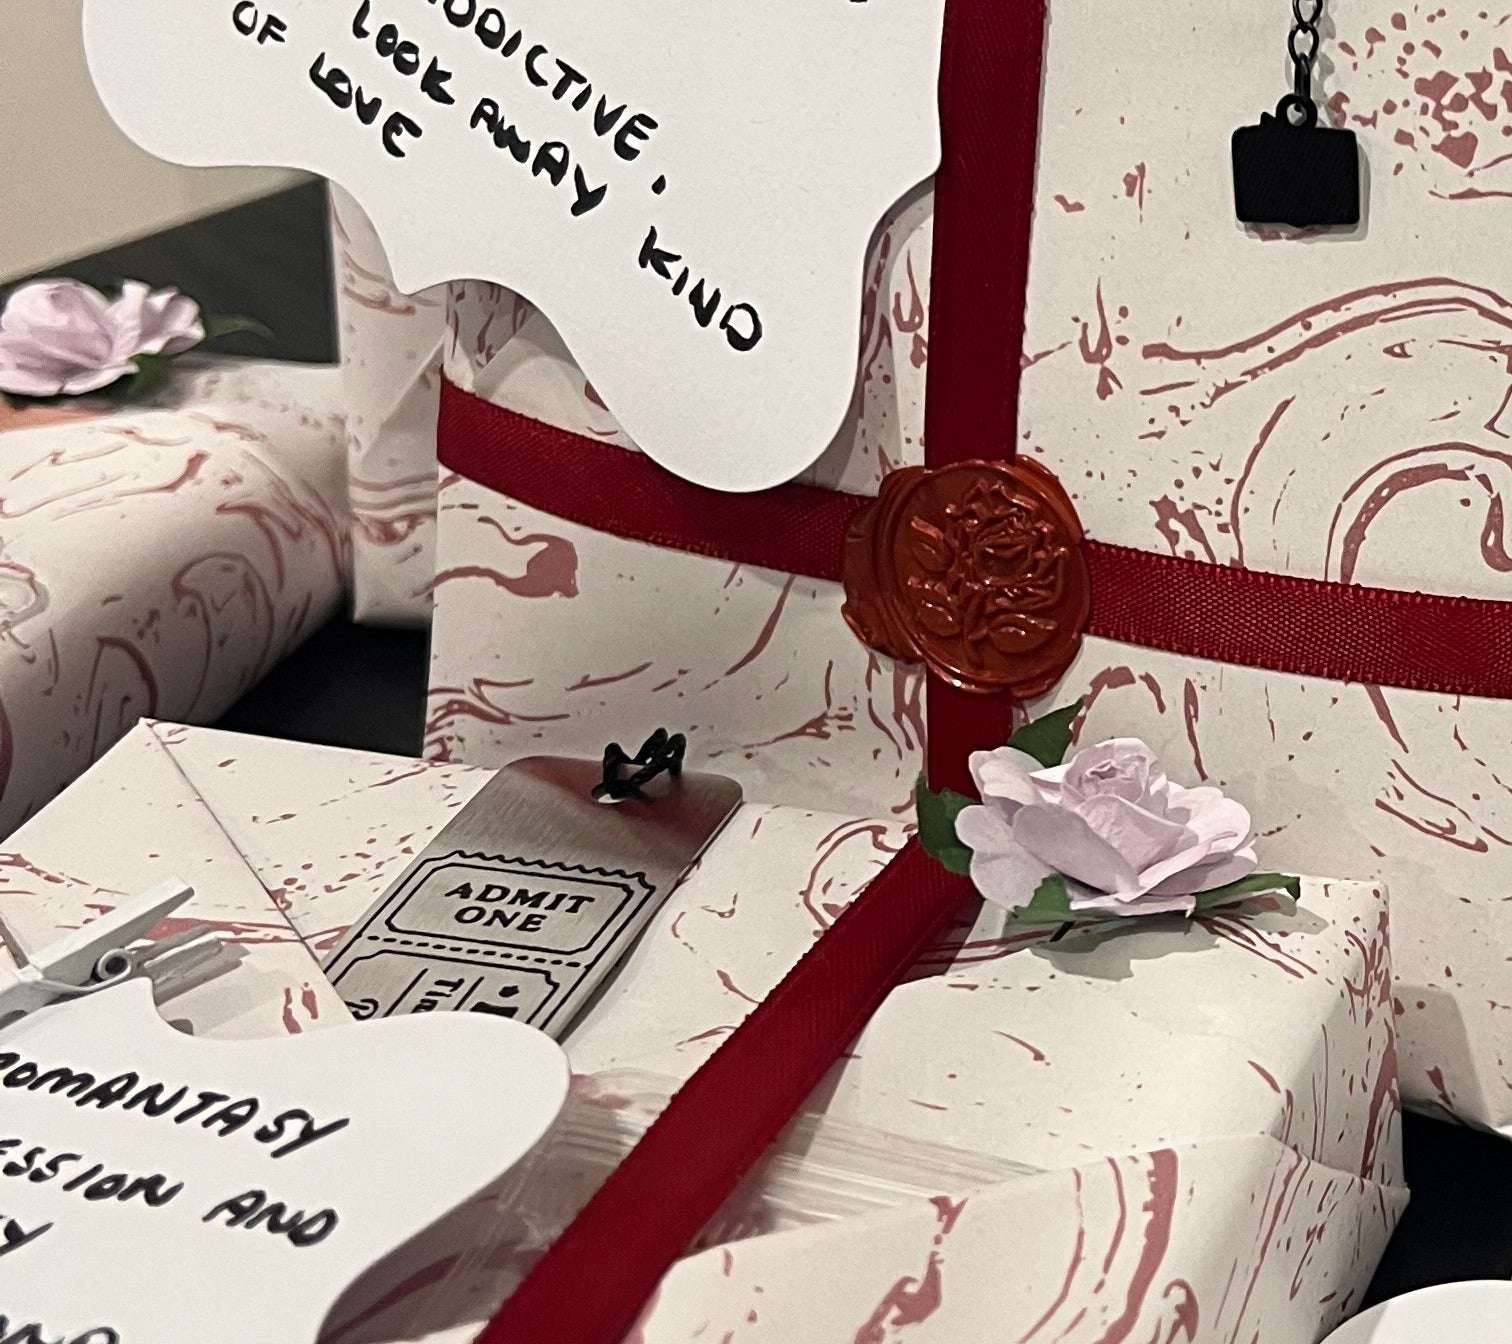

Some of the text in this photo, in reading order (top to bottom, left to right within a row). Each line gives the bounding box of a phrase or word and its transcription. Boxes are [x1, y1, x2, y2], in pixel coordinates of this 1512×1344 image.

[232, 0, 423, 158] OF LOVE
[469, 97, 608, 217] AWAY
[637, 225, 763, 353] KIND
[444, 882, 595, 914] ADMIT
[454, 906, 547, 933] ONE
[202, 1189, 340, 1248] AND
